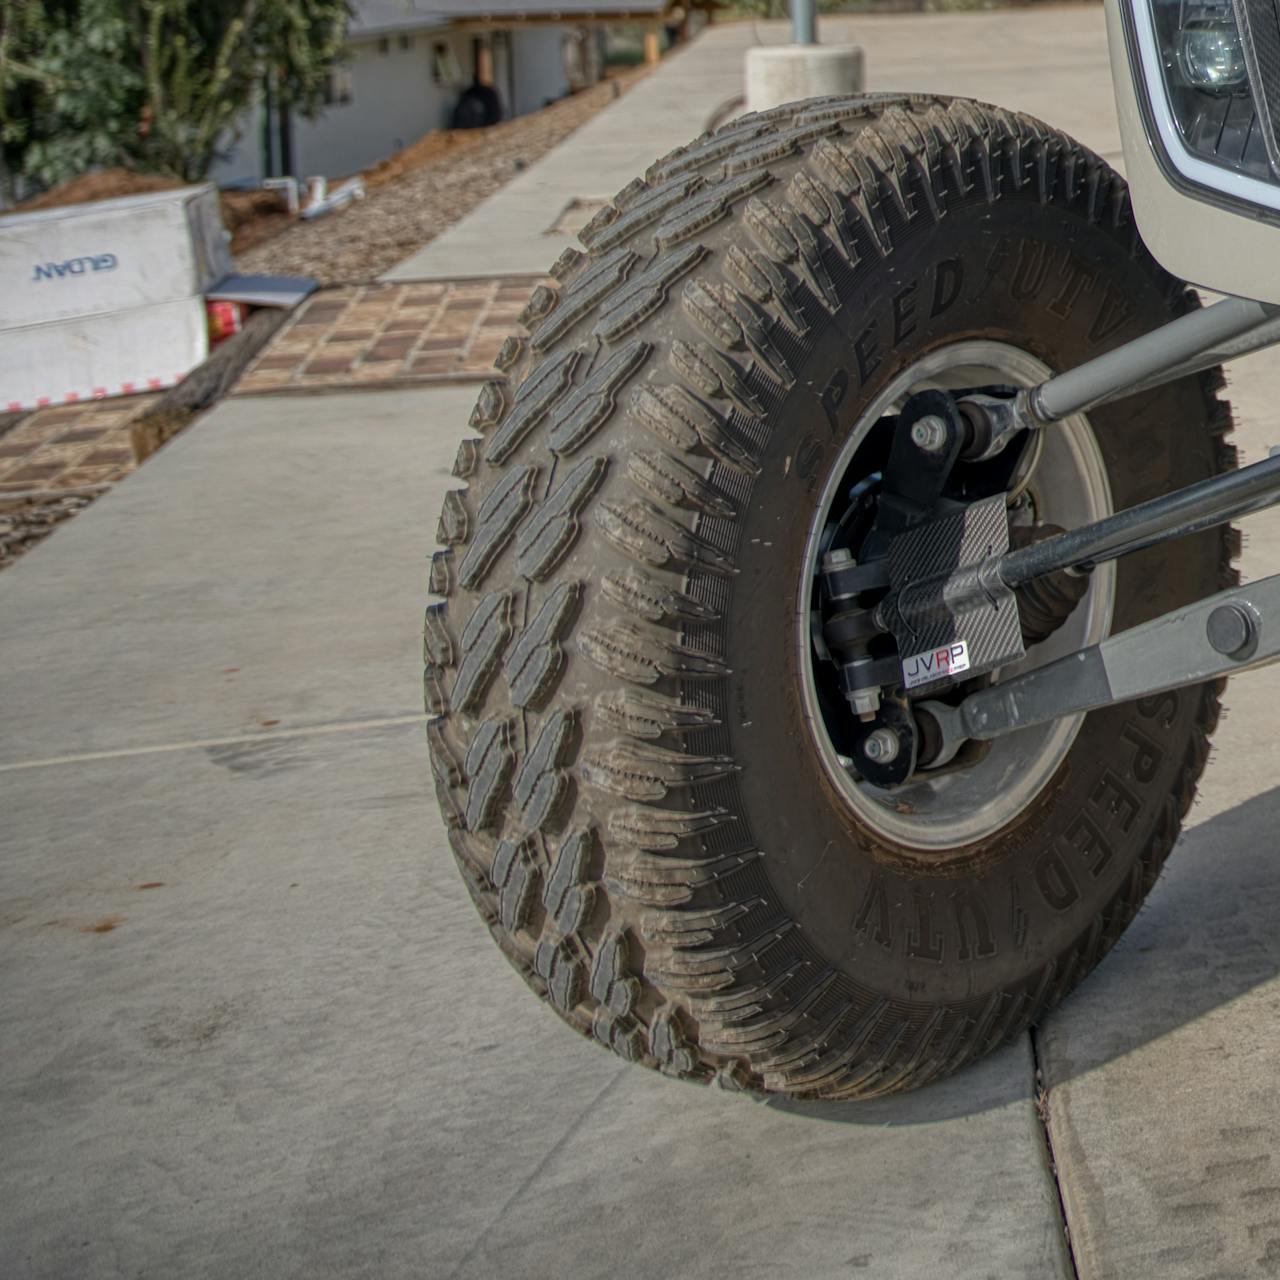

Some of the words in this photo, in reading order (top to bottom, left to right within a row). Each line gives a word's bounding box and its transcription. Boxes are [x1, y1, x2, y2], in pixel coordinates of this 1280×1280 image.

[32, 254, 119, 282] GILDAN
[795, 254, 965, 481] SPEED
[1009, 237, 1139, 348] UTV
[907, 644, 964, 676] JVRP
